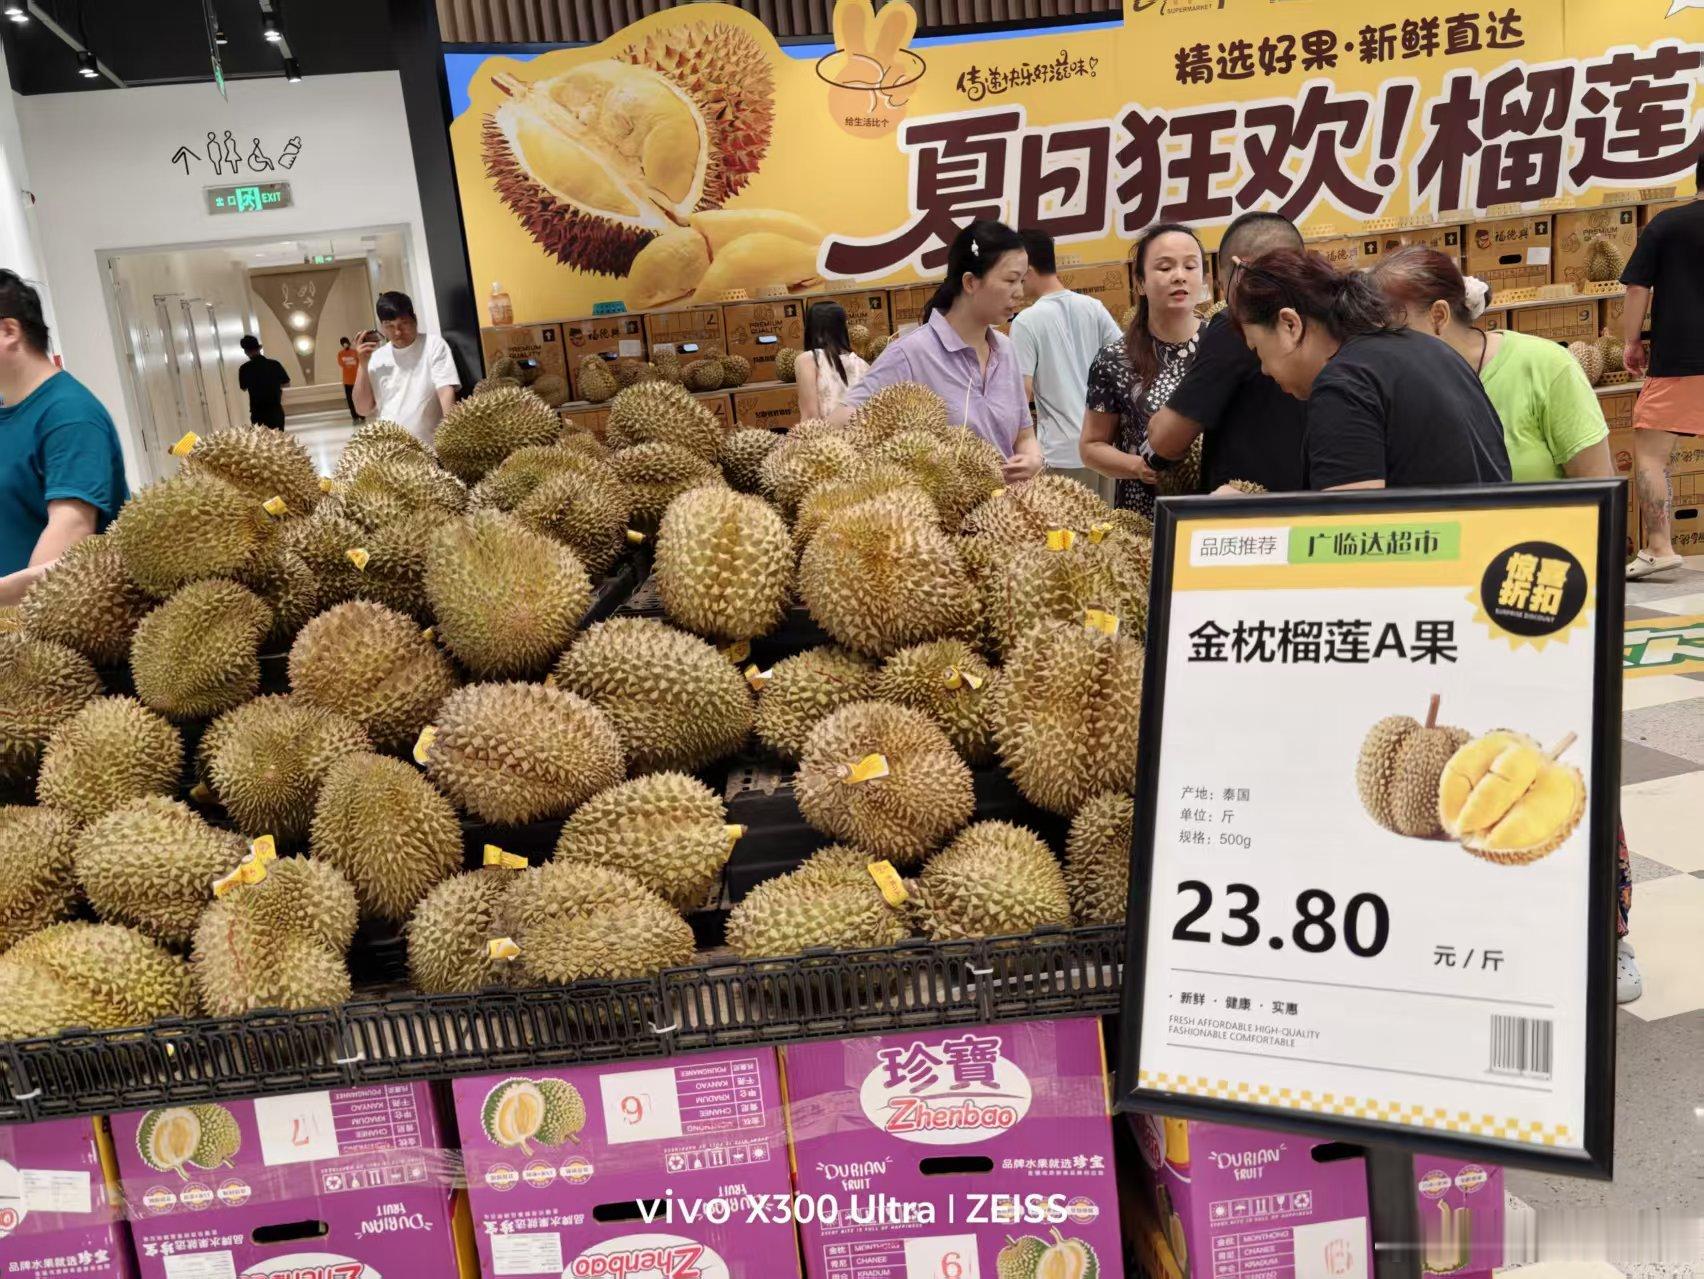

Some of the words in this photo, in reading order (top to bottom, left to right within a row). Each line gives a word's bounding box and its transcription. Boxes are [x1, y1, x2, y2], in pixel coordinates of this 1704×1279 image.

[1167, 4, 1212, 14] SUPERMARKET
[1174, 7, 1525, 84] 精选好果·新鲜直达
[844, 117, 890, 128] 给生活比个
[261, 191, 281, 204] EXIT
[1583, 226, 1618, 236] PREMIUM
[750, 319, 783, 329] PREMIUM
[751, 326, 783, 335] QUALITY
[508, 344, 542, 354] PREMIUM
[509, 351, 541, 360] QUALITY
[1200, 535, 1277, 557] 品质推荐
[1308, 529, 1440, 557] 广临达超市
[1498, 579, 1564, 615] 折扣
[1188, 618, 1458, 665] 金枕榴莲A果
[1172, 879, 1390, 958] 23.80
[1180, 991, 1205, 1006] 新鲜
[1225, 995, 1251, 1011] 健康
[1272, 1000, 1298, 1016] 实惠
[1169, 1014, 1195, 1026] FRESH
[1197, 1018, 1253, 1032] AFFORDABLE
[1255, 1024, 1320, 1040] HIGH-QUALITY
[1168, 1025, 1227, 1040] FASHIONABLE
[1229, 1031, 1295, 1048] COMFORTABLE
[878, 1035, 1001, 1094] 珍寶
[695, 1079, 729, 1090] KANYAO
[695, 1093, 731, 1104] KRADUM
[699, 1107, 732, 1117] CHANEE
[886, 1097, 1018, 1132] Zhenbao
[1217, 1148, 1280, 1170] DURIAN
[824, 1160, 886, 1180] DURIAN
[1234, 1166, 1264, 1182] FRUIT
[718, 1183, 748, 1198] FRUIT
[841, 1178, 871, 1192] FRUIT
[376, 1201, 407, 1218] FRUIT
[361, 1212, 426, 1235] DURIAN
[1243, 1230, 1290, 1242] MONTHONG
[573, 1243, 703, 1279] Zhenbao
[856, 1256, 887, 1265] CHANEE
[856, 1269, 891, 1278] KRADUM
